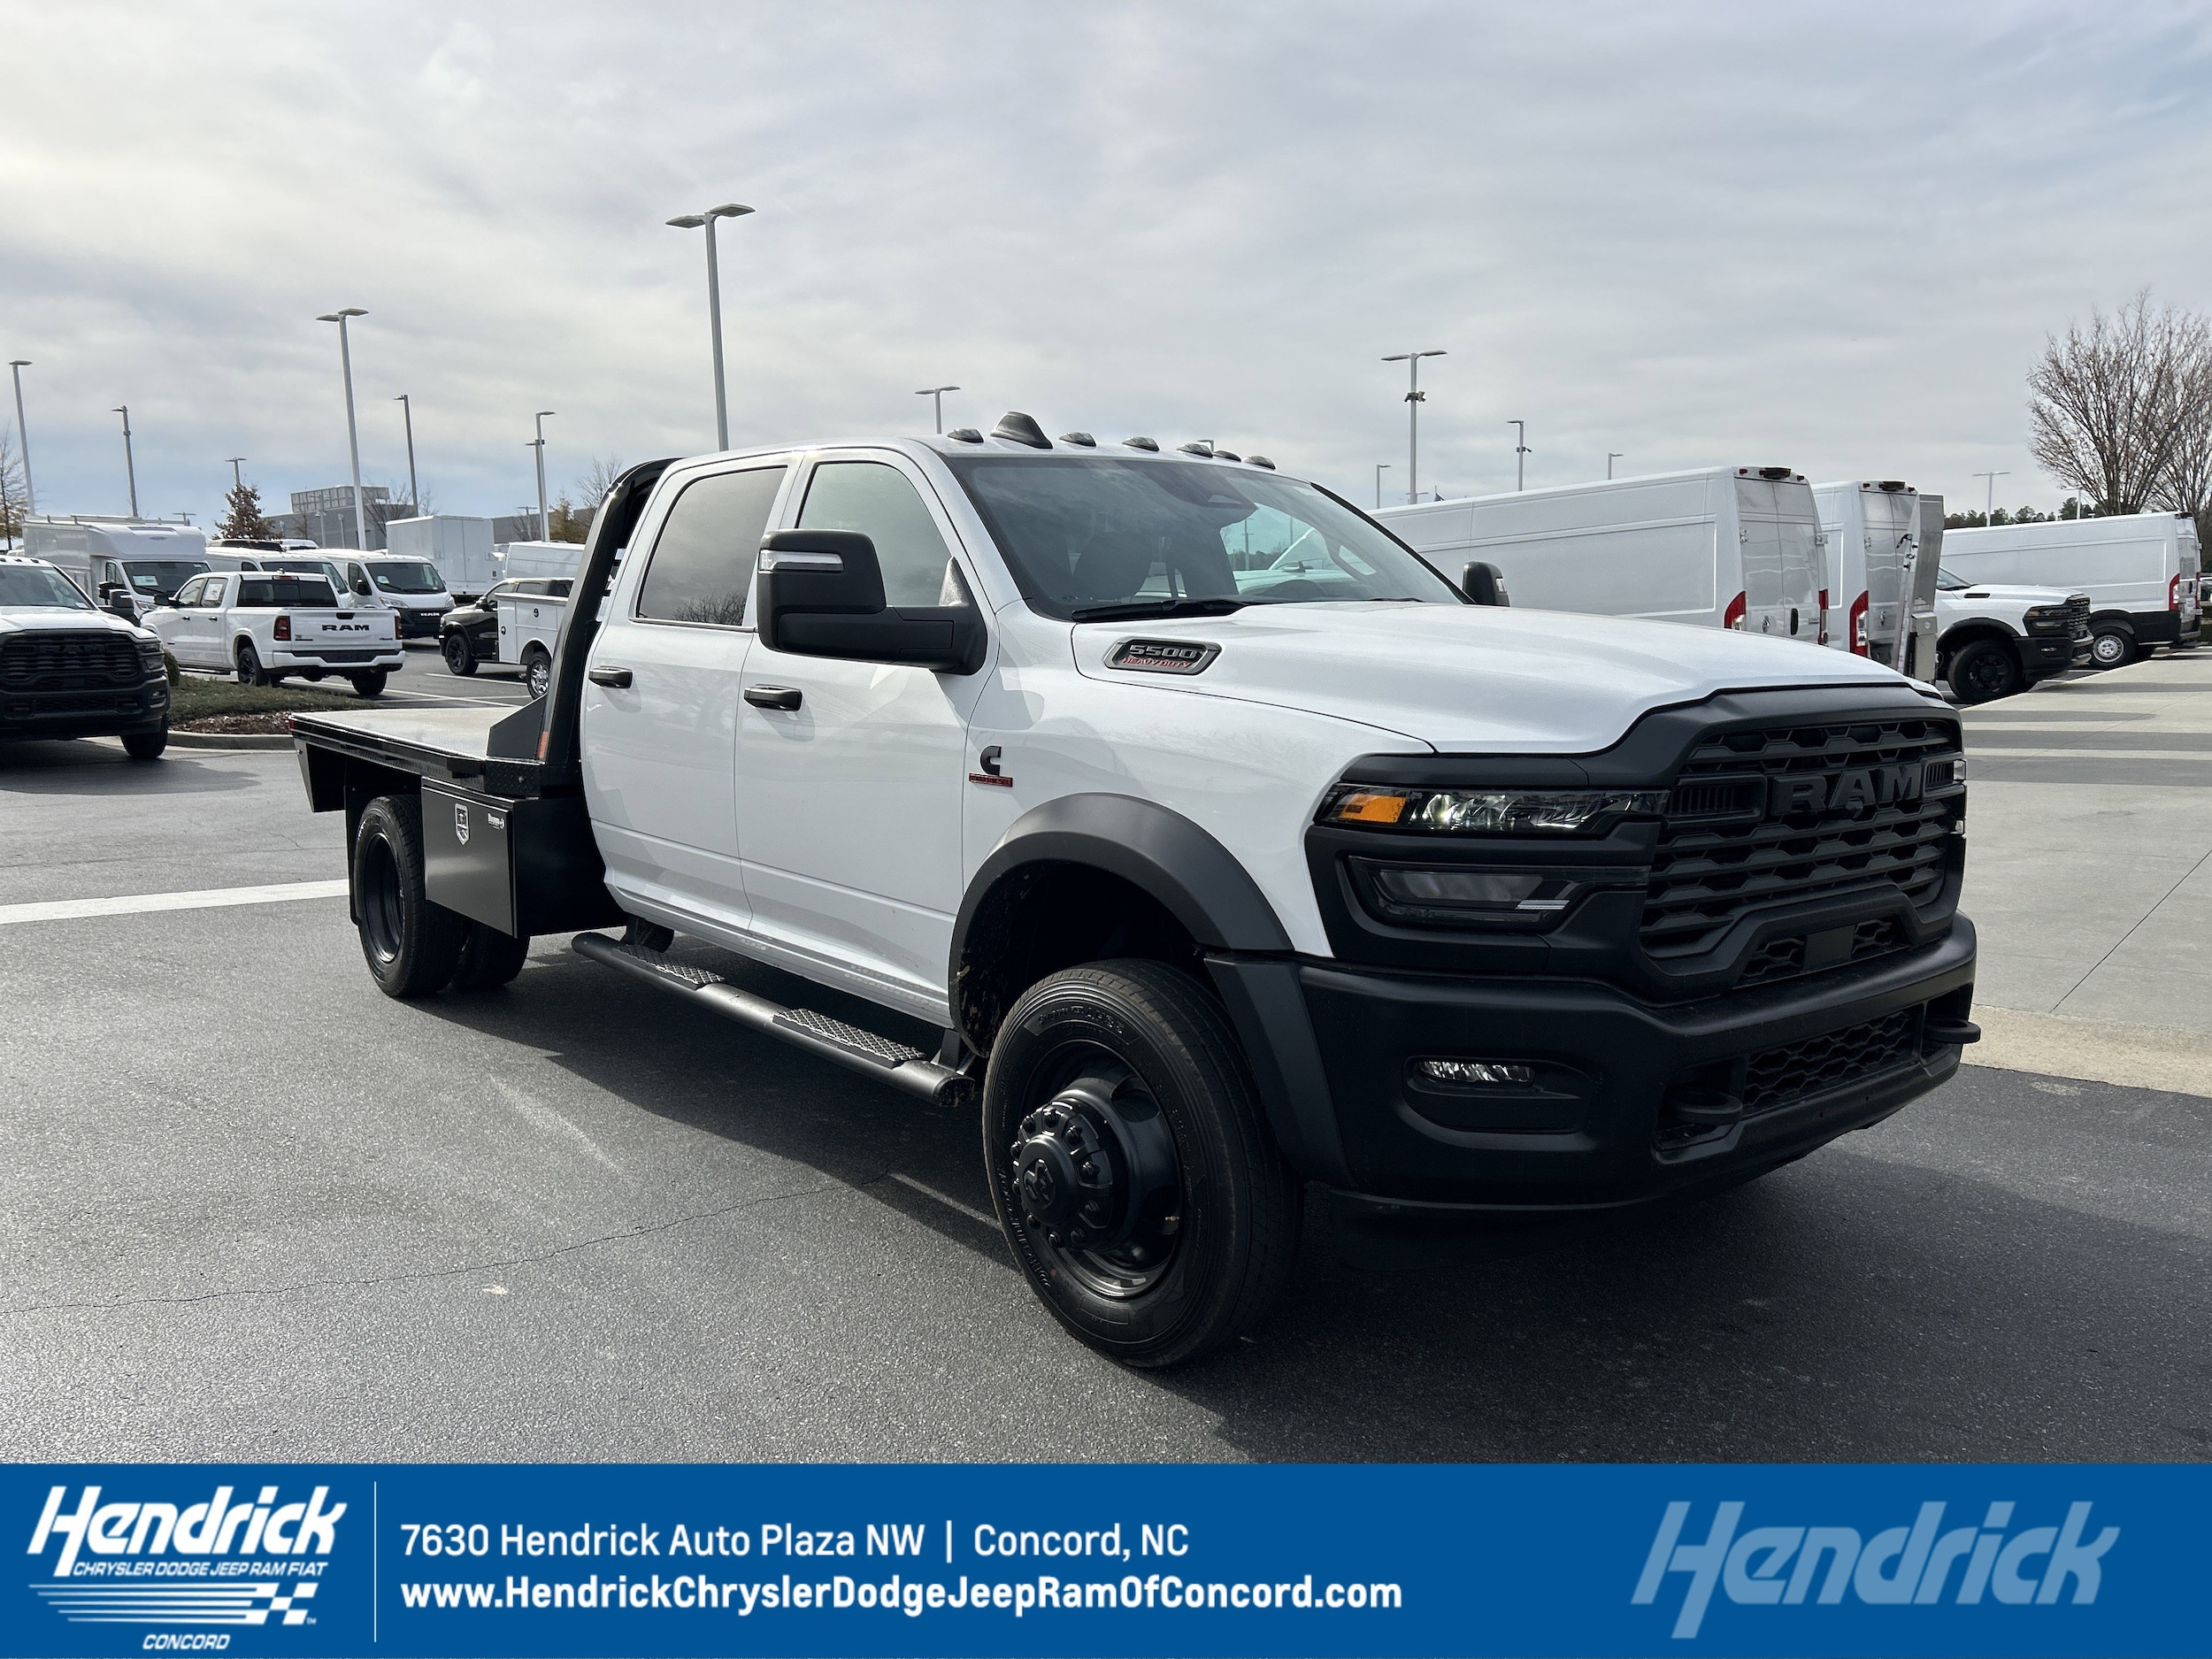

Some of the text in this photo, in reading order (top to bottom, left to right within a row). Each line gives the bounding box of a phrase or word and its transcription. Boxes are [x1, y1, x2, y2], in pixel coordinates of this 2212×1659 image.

[39, 644, 105, 654] RAM
[1128, 644, 1198, 659] 5500
[1122, 657, 1192, 668] HEAVY DUTY
[1772, 764, 1922, 815] RAM
